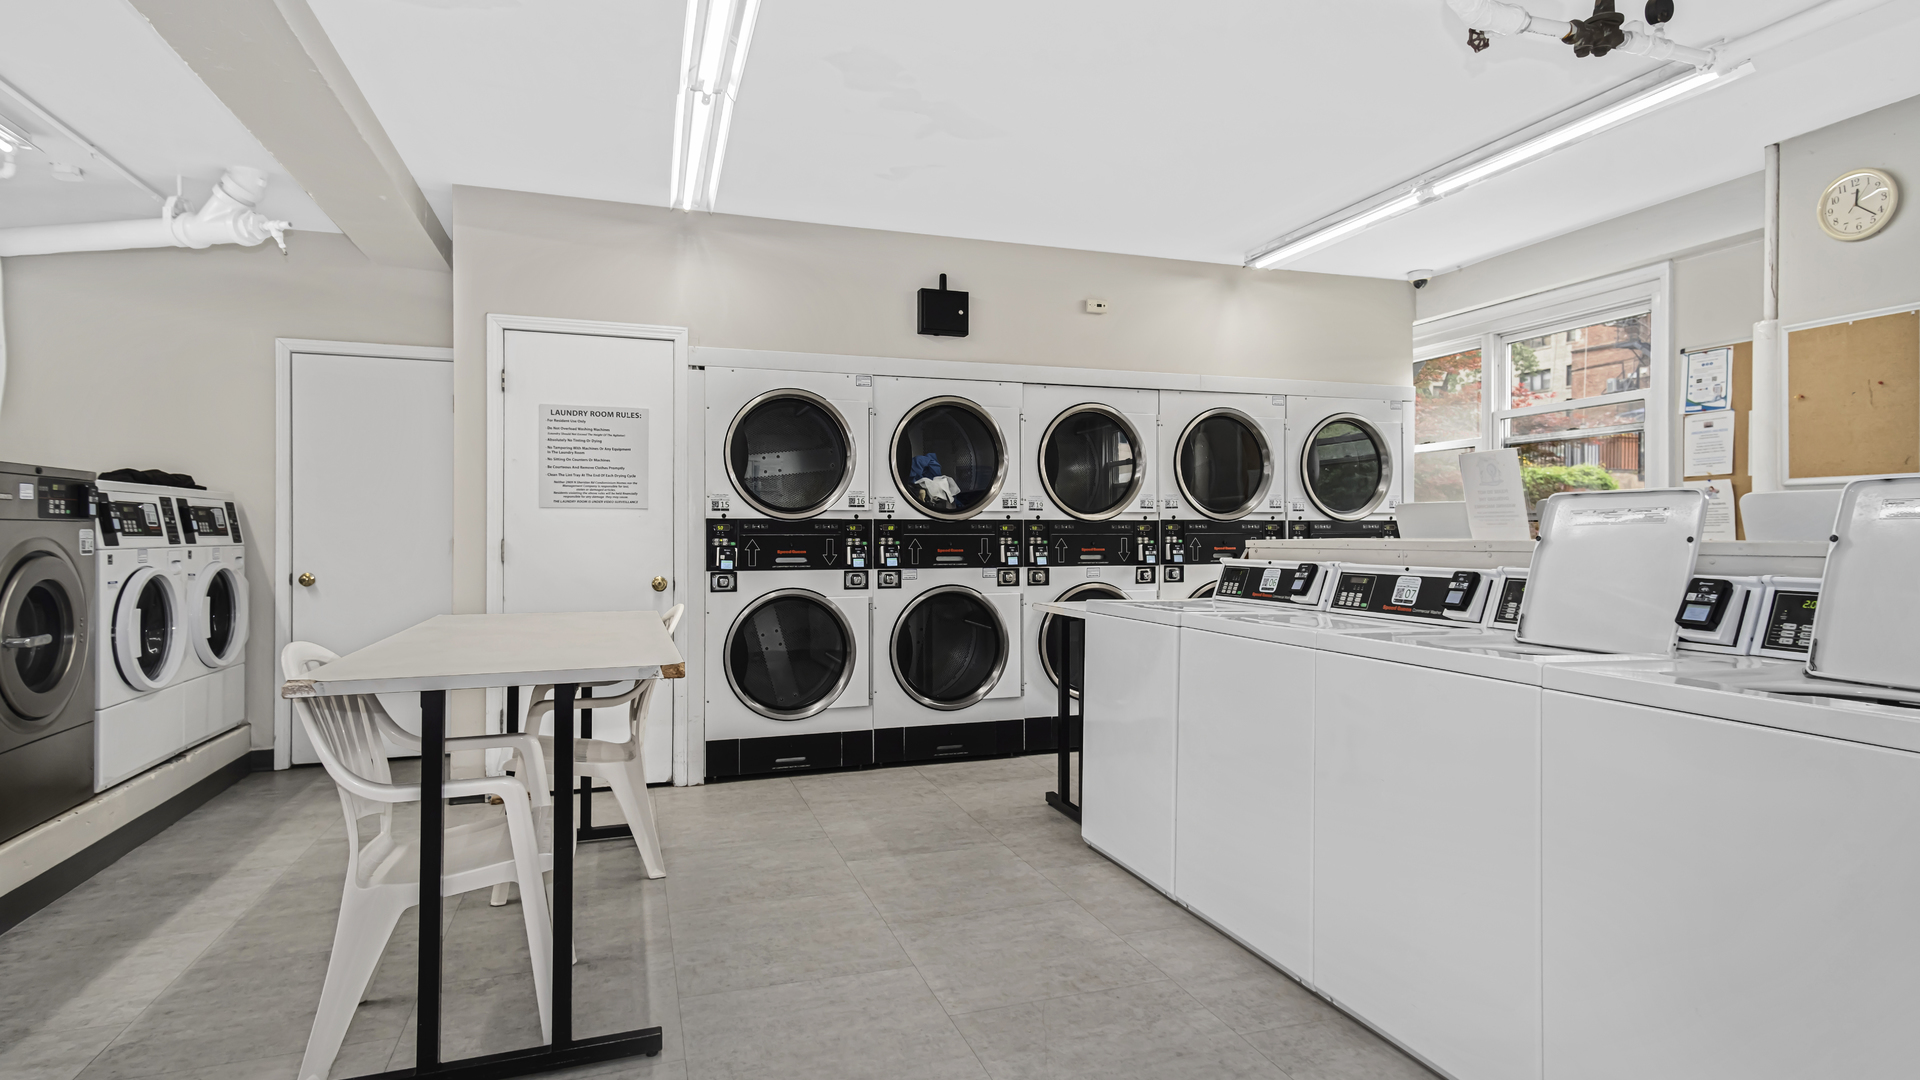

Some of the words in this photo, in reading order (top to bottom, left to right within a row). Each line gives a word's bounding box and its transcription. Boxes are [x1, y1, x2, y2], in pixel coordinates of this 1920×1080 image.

[1851, 178, 1860, 188] 12
[1866, 177, 1870, 185] 1
[1838, 185, 1847, 194] 11
[1881, 192, 1887, 200] 3
[1831, 196, 1839, 205] 10
[1828, 208, 1833, 216] 9
[1870, 216, 1876, 224] 5
[1843, 222, 1849, 230] 7
[1856, 222, 1862, 230] 6
[1405, 589, 1416, 598] 07
